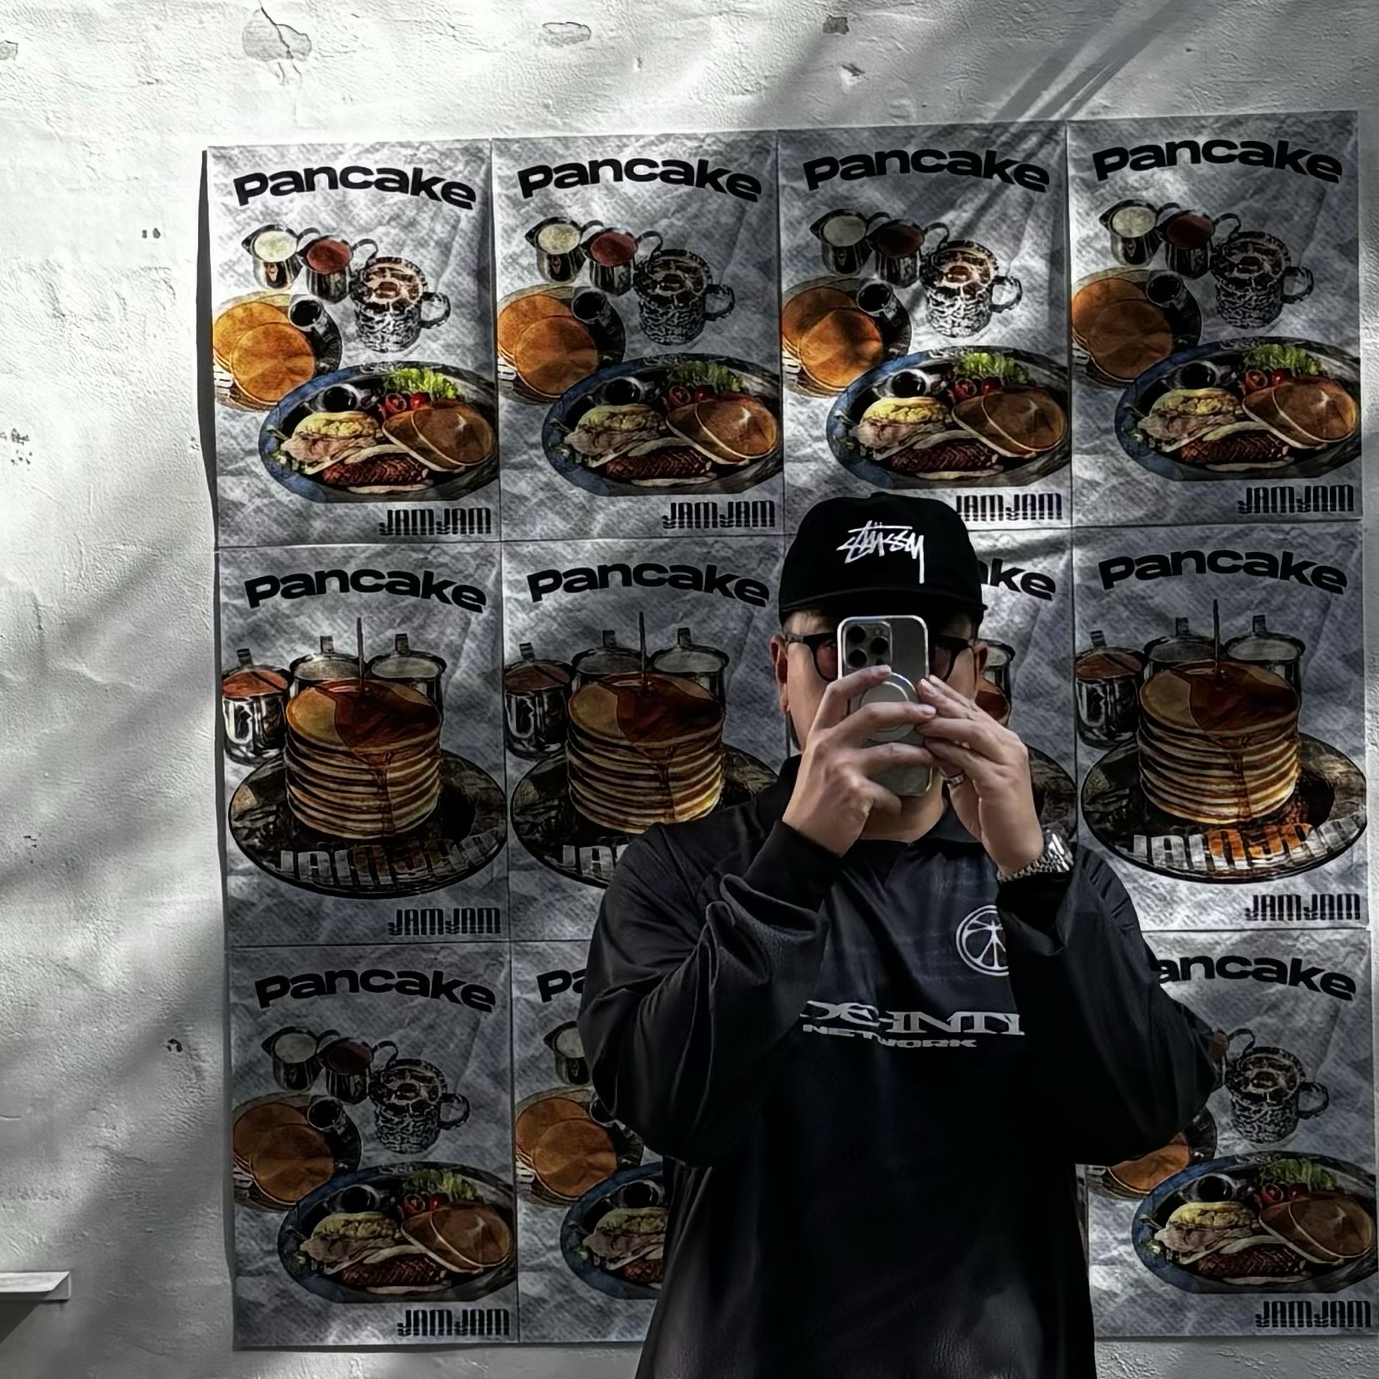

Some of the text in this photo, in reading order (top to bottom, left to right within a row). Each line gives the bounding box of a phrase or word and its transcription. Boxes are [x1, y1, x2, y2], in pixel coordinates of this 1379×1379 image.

[1237, 483, 1355, 513] JAMJAM
[378, 508, 492, 536] JAMJAM
[661, 500, 776, 530] JAMJAM
[388, 907, 501, 936] JAMJAM
[1244, 893, 1361, 921] JAMJAM
[1157, 955, 1356, 1001] ancake
[803, 1024, 978, 1048] NETWORK
[397, 1308, 510, 1337] JAMJAM
[1255, 1299, 1372, 1328] JAMJAM
